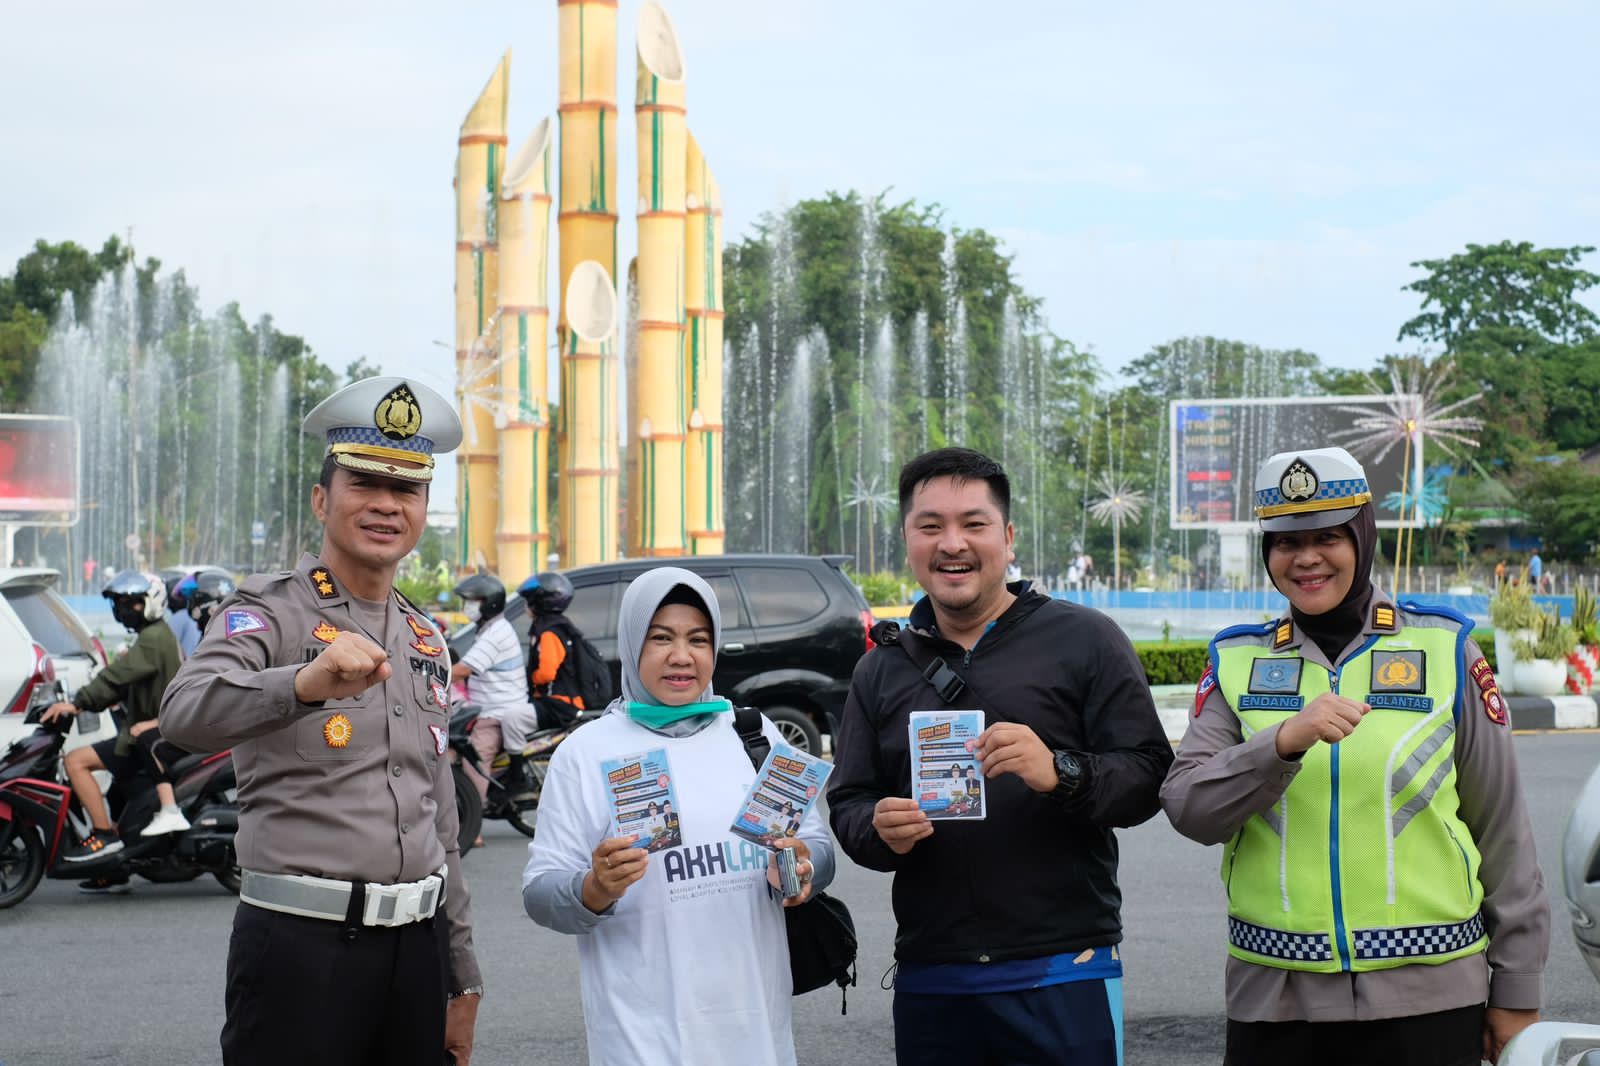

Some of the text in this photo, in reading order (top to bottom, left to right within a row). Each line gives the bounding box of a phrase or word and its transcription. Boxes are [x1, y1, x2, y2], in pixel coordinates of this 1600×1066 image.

[1242, 695, 1300, 708] ENDANG
[1368, 694, 1429, 710] POLANTAS
[664, 839, 768, 883] AKHLAK
